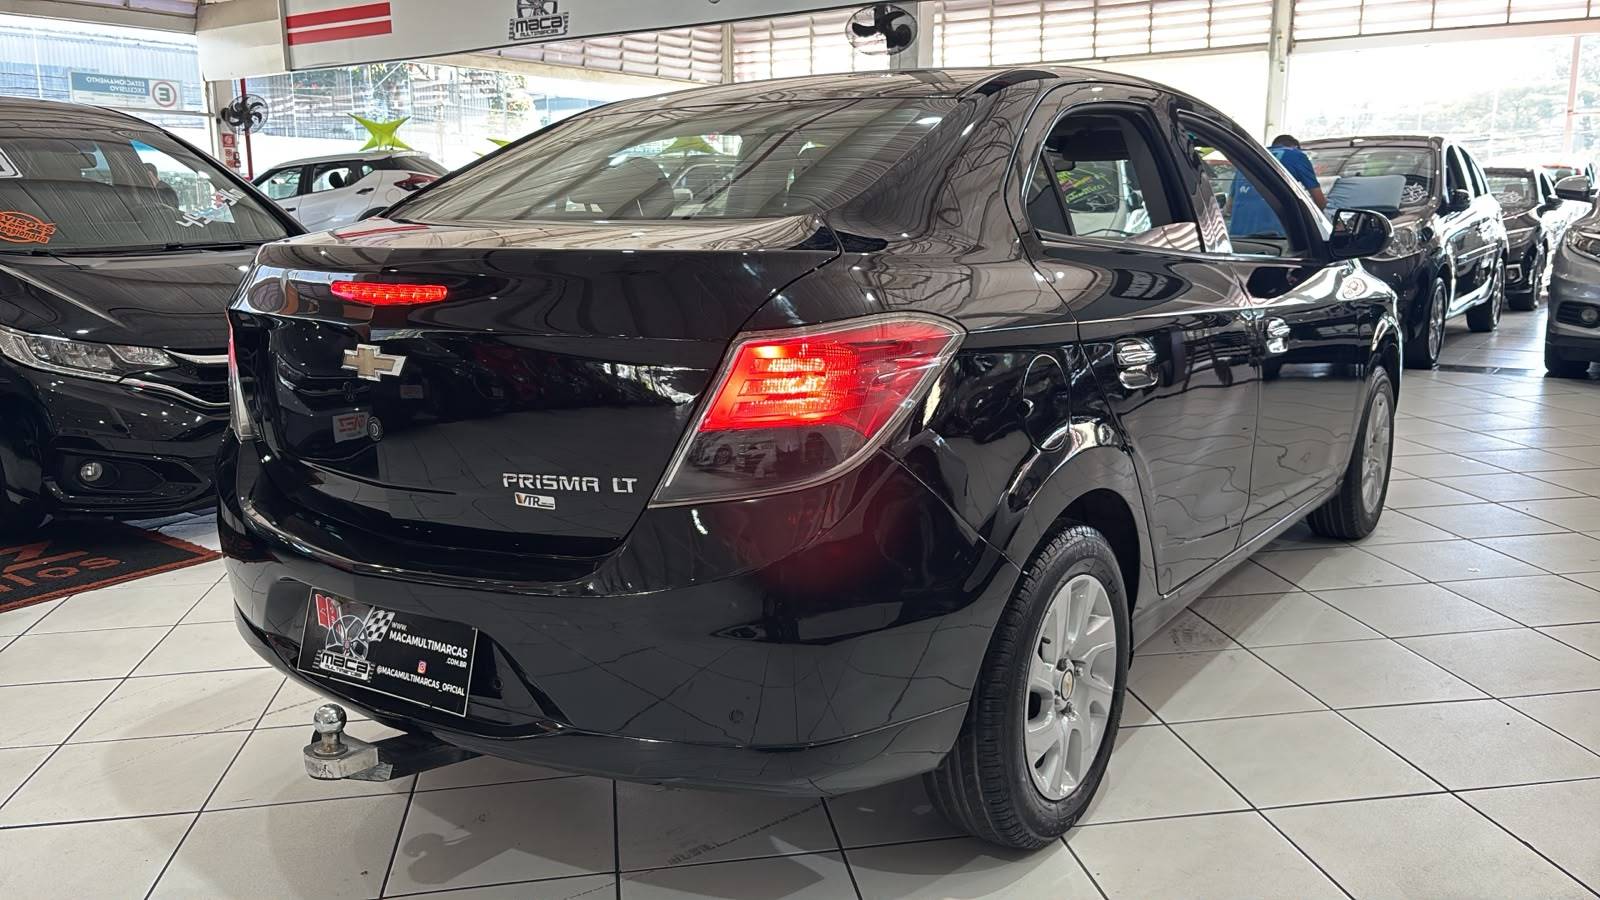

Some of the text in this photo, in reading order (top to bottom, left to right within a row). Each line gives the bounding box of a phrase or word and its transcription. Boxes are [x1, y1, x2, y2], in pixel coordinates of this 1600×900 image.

[502, 472, 638, 493] PRISMA LT
[389, 630, 469, 659] MACAMULTIMARCAS
[446, 657, 468, 669] .COM.BR
[376, 665, 466, 697] @MACAMULTIMARCAS_OFICIAL
